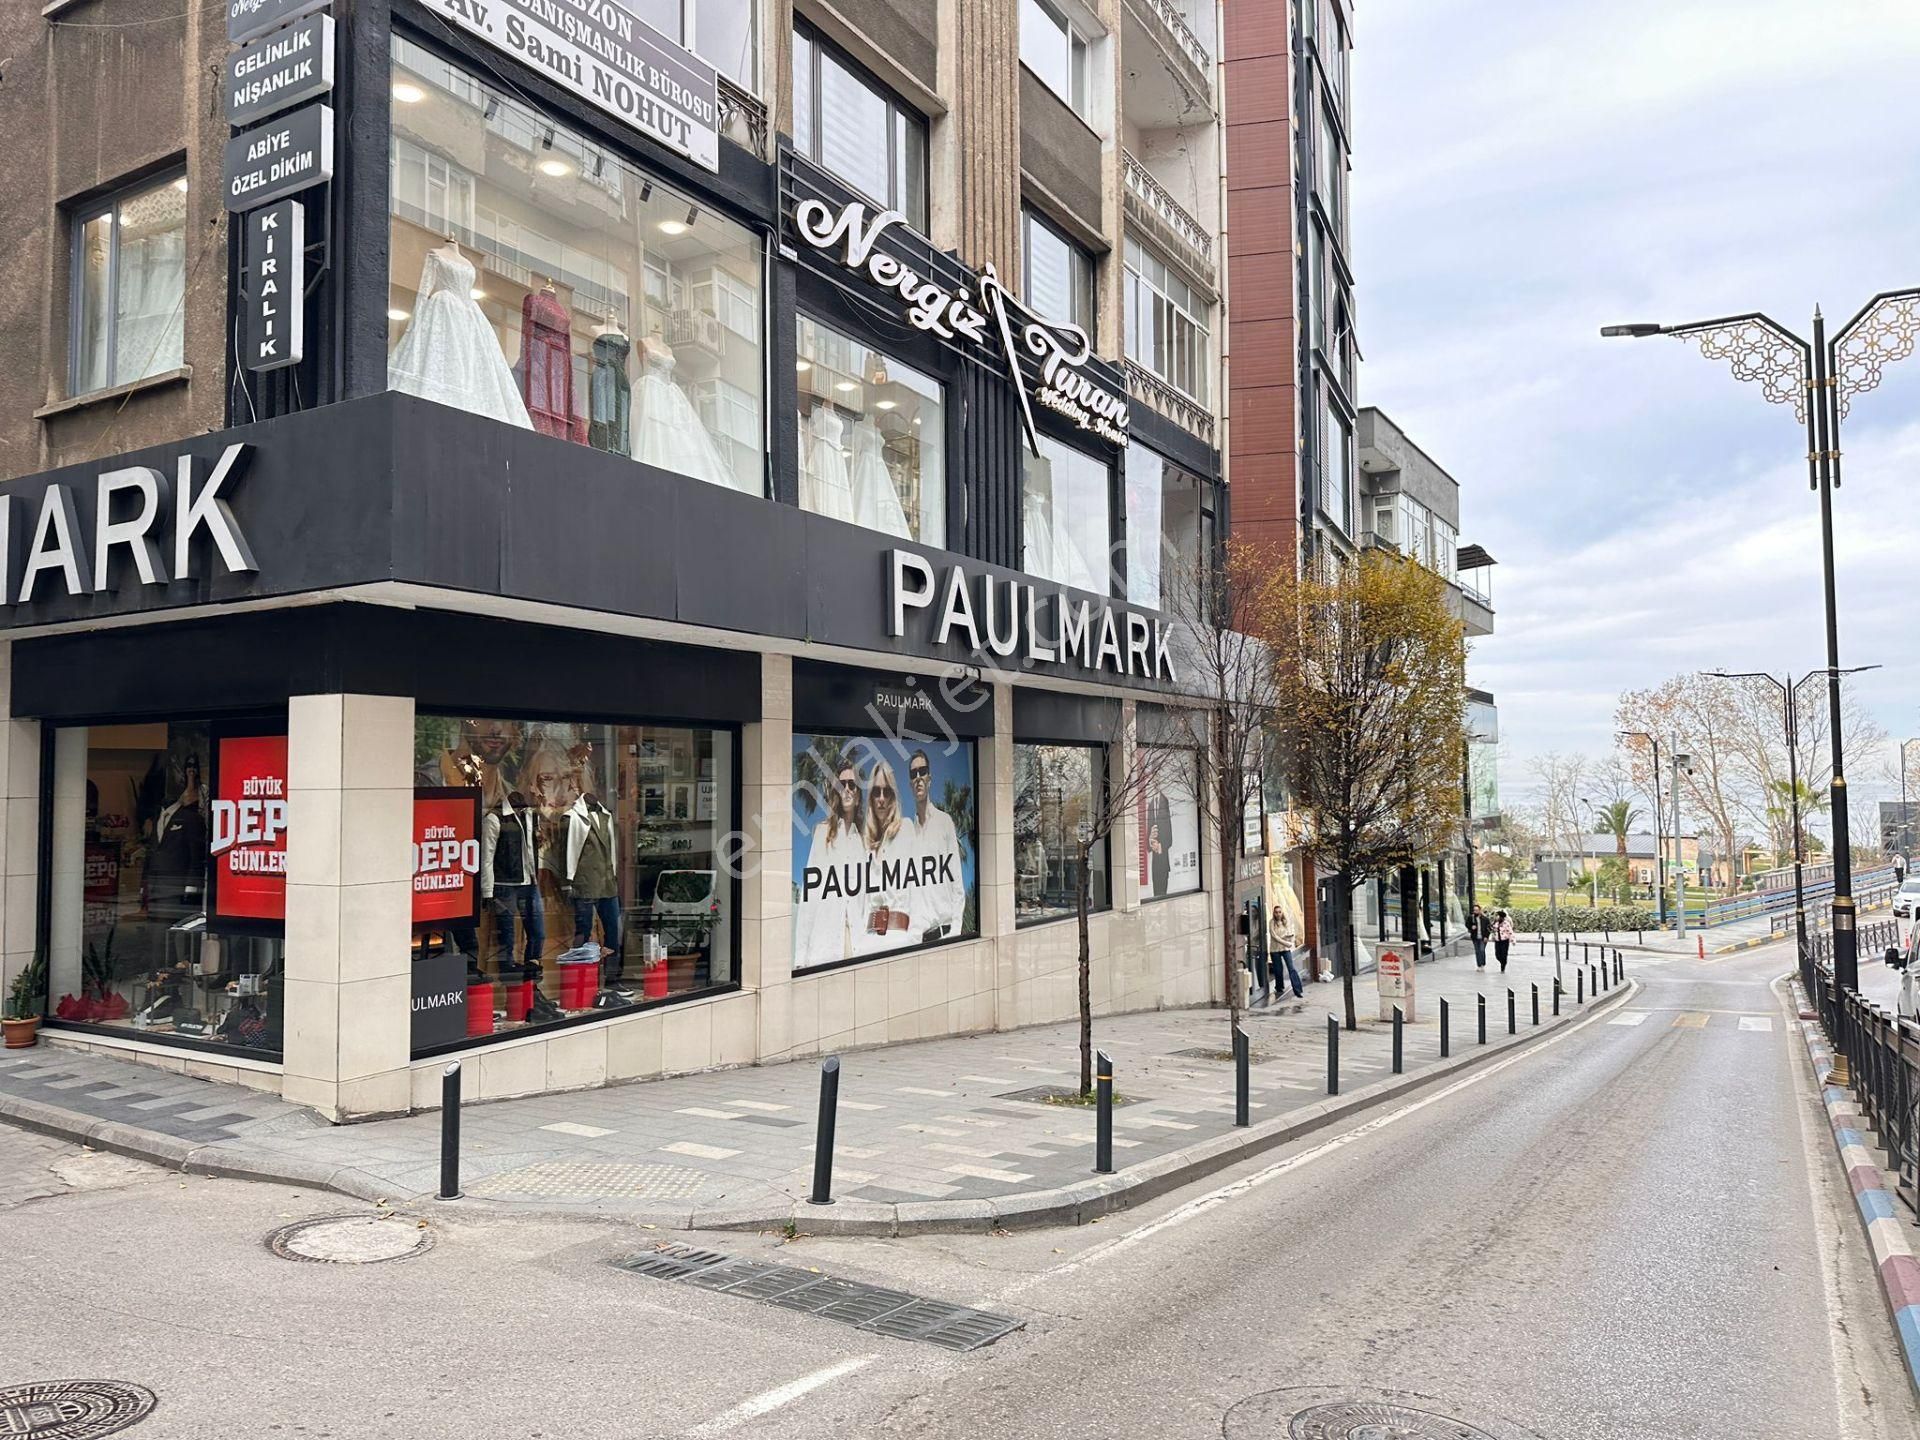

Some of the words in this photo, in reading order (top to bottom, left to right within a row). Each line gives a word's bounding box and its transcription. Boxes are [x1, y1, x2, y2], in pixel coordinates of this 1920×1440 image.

[234, 29, 312, 78] GELİNLİK
[516, 0, 646, 82] ANIŞMANLIK
[649, 66, 713, 123] BÜROSU
[233, 58, 313, 107] NİŞANLIK
[506, 14, 583, 86] Sami
[592, 65, 691, 149] NOHUT
[247, 130, 290, 162] ABİYE
[231, 172, 267, 196] ÖZEL
[270, 151, 313, 182] DİKİM
[260, 212, 279, 358] KİRALIK
[797, 200, 987, 344] Nergiz
[1025, 321, 1130, 428] Turan
[0, 443, 255, 605] ARK
[889, 548, 1178, 683] PAULMARK
[876, 693, 933, 711] PAULMARK
[243, 776, 283, 796] BÜYÜK
[424, 825, 456, 839] BÜYÜK
[414, 871, 465, 891] GÜNLERİ
[802, 853, 955, 902] PAULMARK
